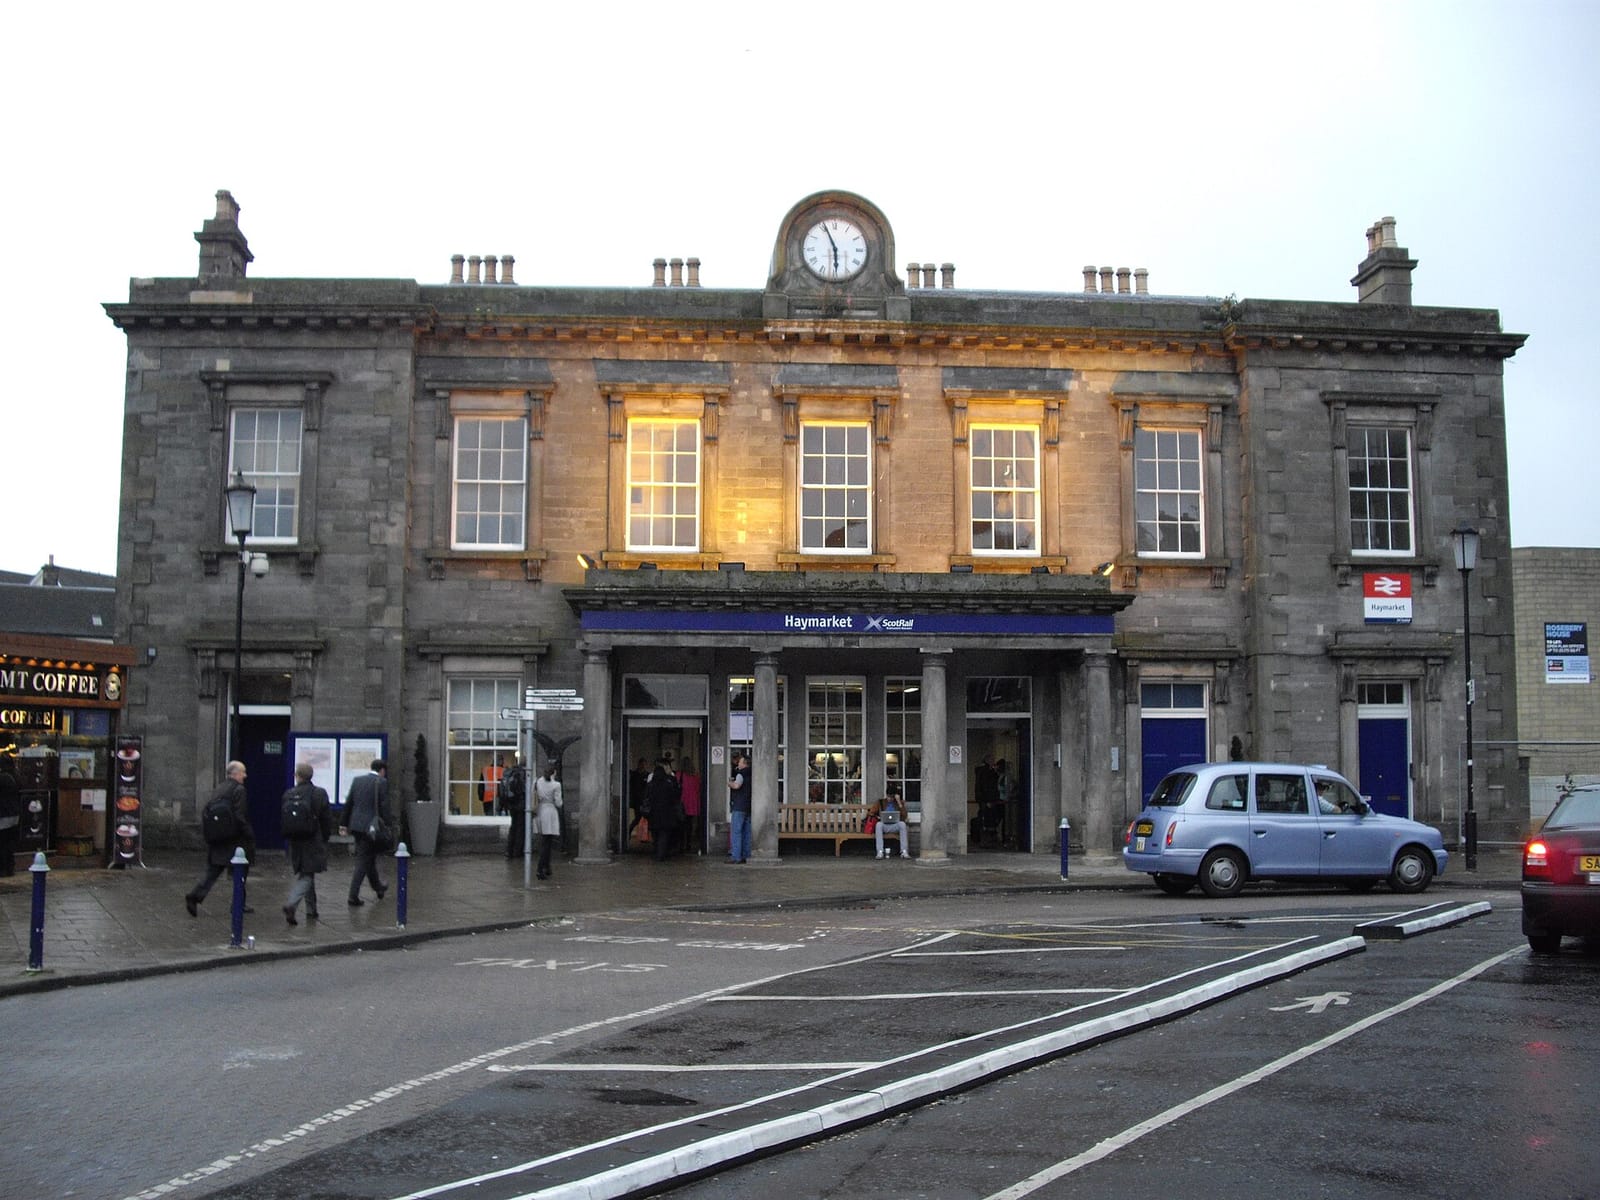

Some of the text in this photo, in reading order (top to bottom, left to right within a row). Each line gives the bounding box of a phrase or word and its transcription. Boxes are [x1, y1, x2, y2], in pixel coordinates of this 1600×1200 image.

[1371, 603, 1406, 612] Haymarket
[785, 615, 914, 630] Haymarket ScotRail
[1546, 624, 1583, 632] ROSEBERY
[32, 672, 98, 694] COFFEE
[0, 709, 51, 726] COFFEE
[453, 957, 668, 973] TAXIS
